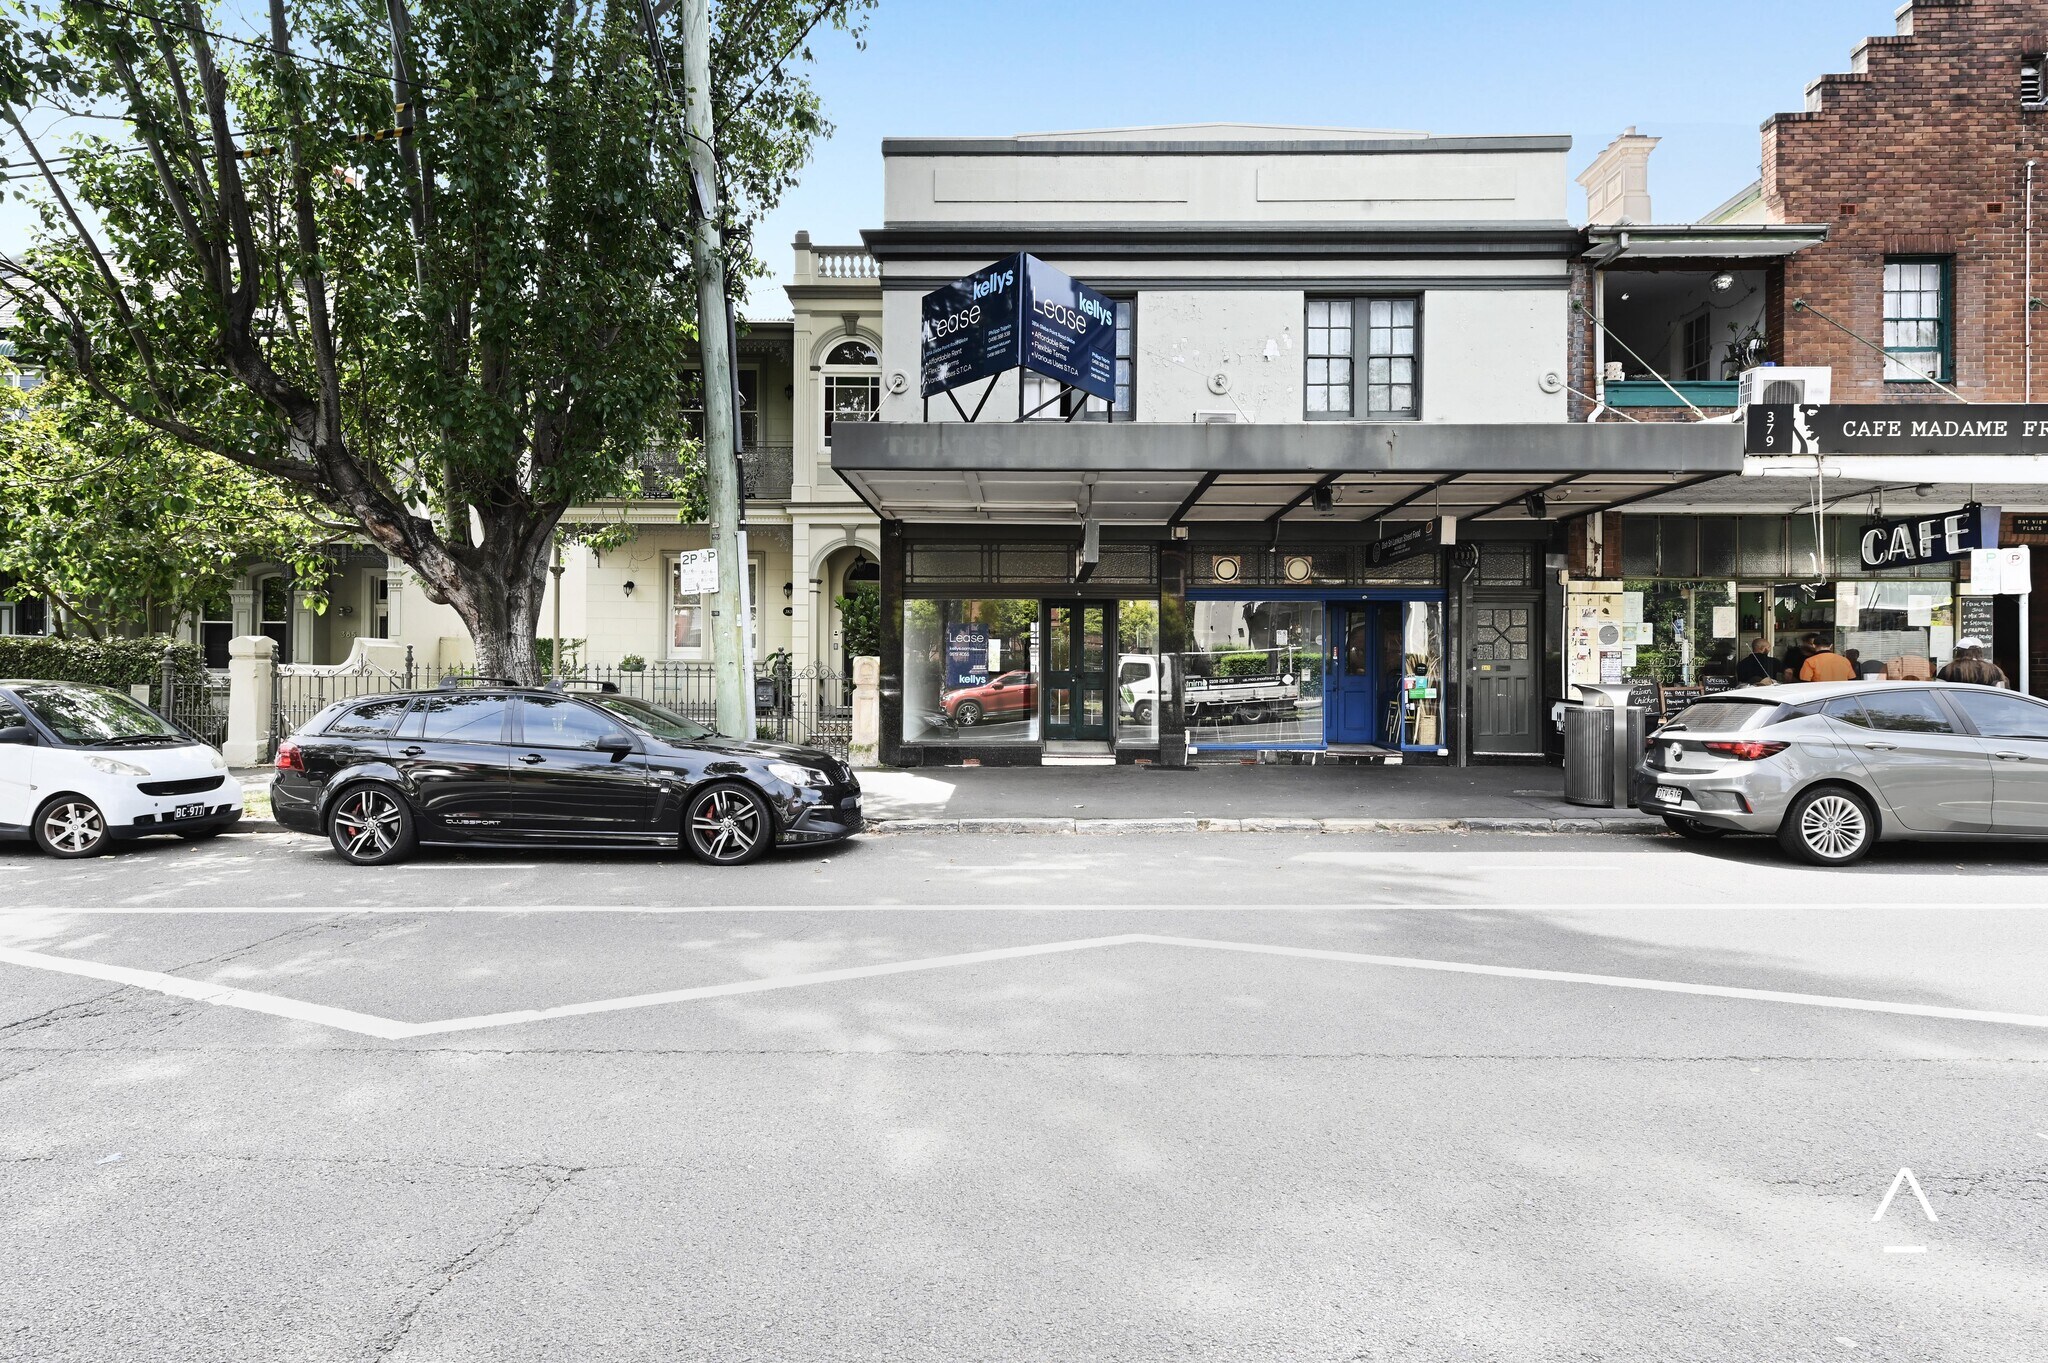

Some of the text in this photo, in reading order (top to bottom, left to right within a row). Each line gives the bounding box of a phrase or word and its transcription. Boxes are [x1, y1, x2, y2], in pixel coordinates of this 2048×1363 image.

[973, 269, 1014, 301] kellys
[1033, 286, 1087, 334] Lease
[1079, 291, 1113, 326] kellys
[927, 305, 981, 342] Lease
[1034, 331, 1070, 353] Affordable Rent
[1034, 340, 1067, 362] Flexible Terms
[928, 348, 962, 366] Affordable Rent
[1034, 352, 1053, 365] Various
[1052, 360, 1064, 370] Uses
[1766, 411, 1775, 447] 379
[1842, 420, 1901, 437] CAFE
[1910, 420, 2008, 437] MADAME
[1412, 529, 1421, 539] Food
[1861, 512, 1975, 566] CAFE
[682, 554, 698, 565] 2P
[949, 633, 984, 643] Lease
[959, 675, 986, 685] kellys
[445, 818, 501, 826] CLUBSPORT
